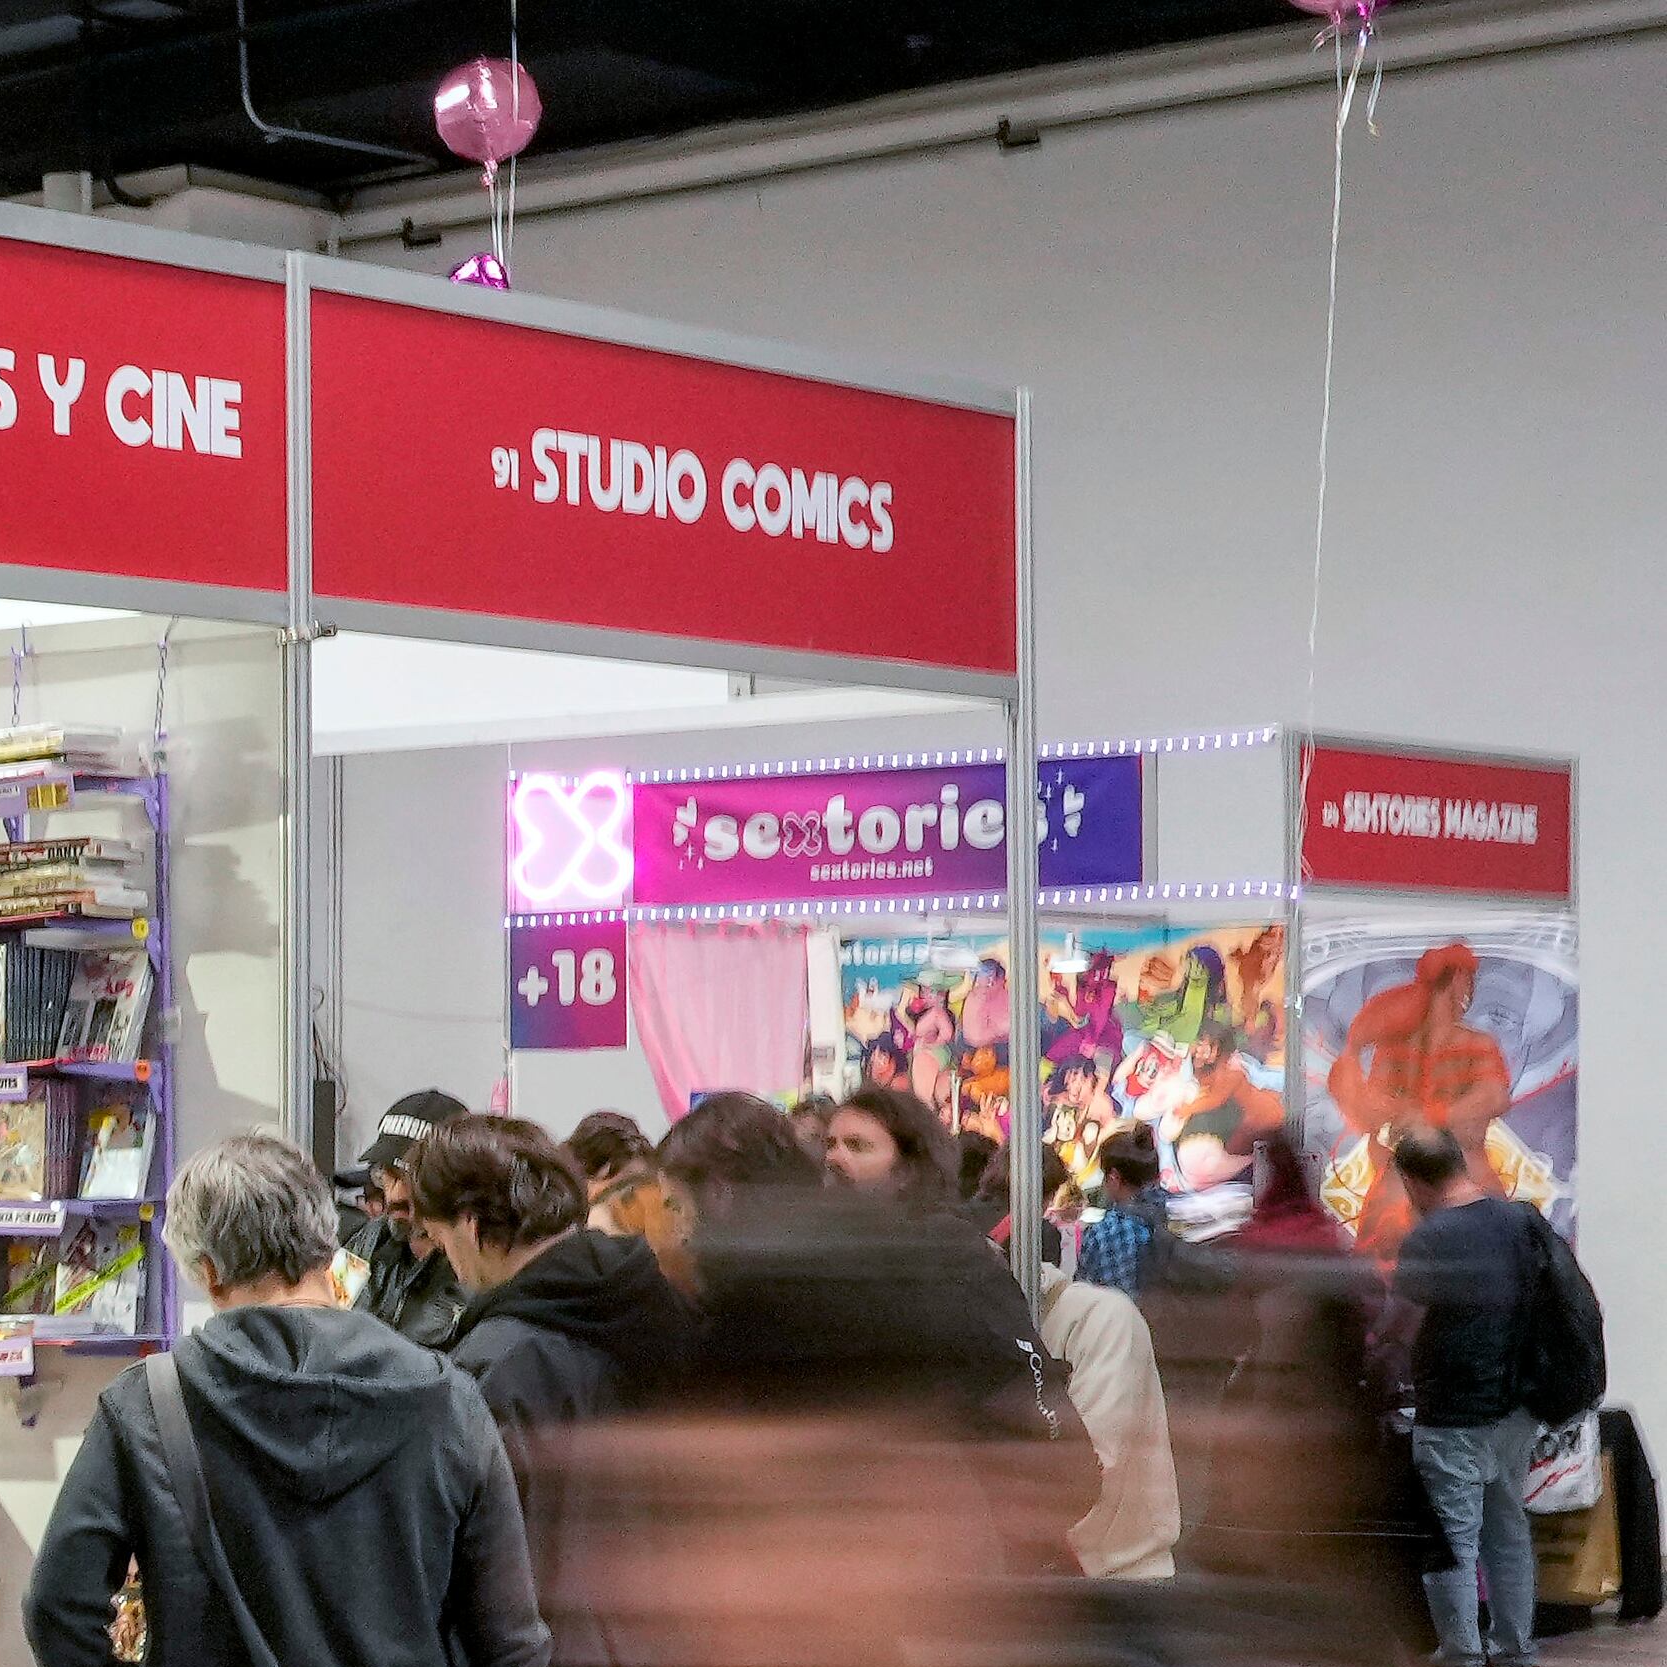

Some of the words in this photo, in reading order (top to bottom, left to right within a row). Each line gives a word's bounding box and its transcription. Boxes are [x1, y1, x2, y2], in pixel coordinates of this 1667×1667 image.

[37, 353, 86, 436] Y
[104, 365, 242, 458] CINE
[491, 446, 520, 491] 91
[531, 427, 707, 525] STUDIO
[721, 457, 895, 553] COMICS
[810, 855, 935, 883] sextories.net
[517, 948, 618, 1008] +18
